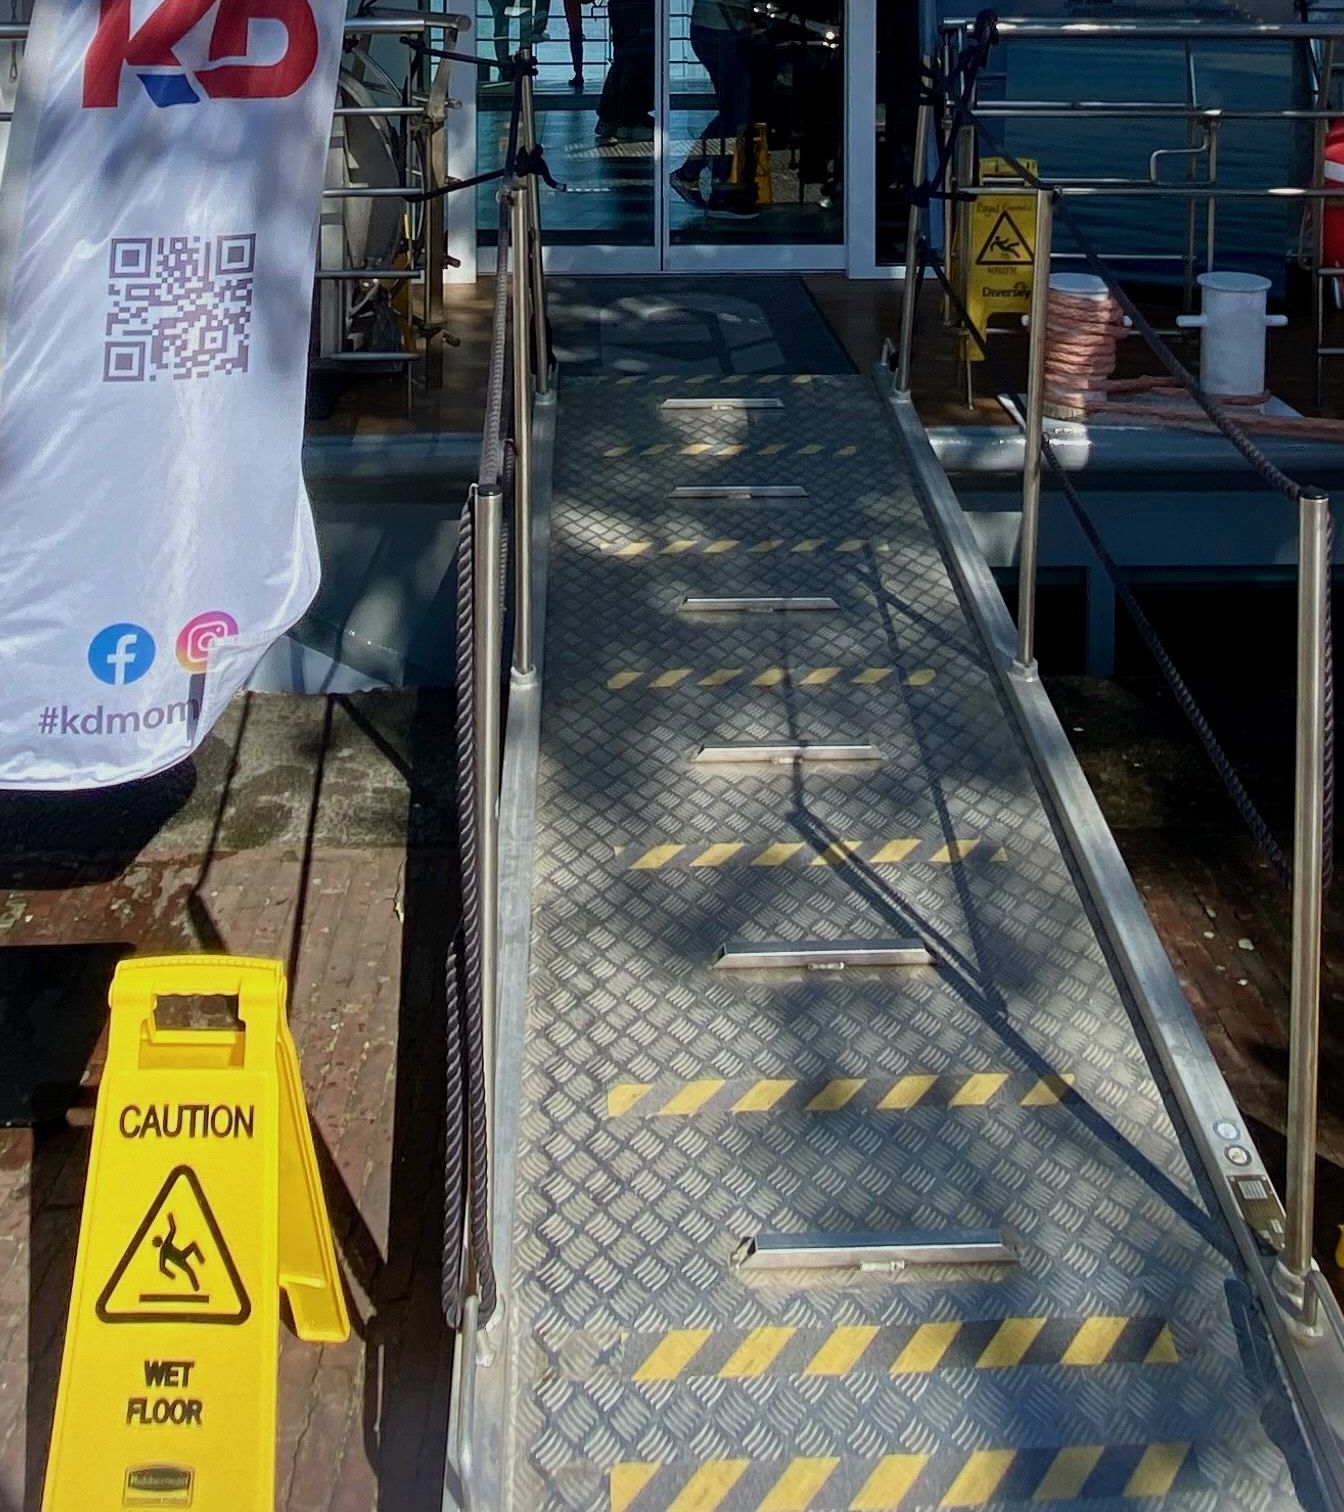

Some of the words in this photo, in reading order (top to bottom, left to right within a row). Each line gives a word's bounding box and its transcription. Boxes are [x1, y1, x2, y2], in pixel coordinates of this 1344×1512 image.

[982, 286, 1032, 303] Diversey
[118, 1103, 255, 1139] CAUTION
[143, 1359, 196, 1388] WET
[126, 1397, 203, 1426] FLOOR
